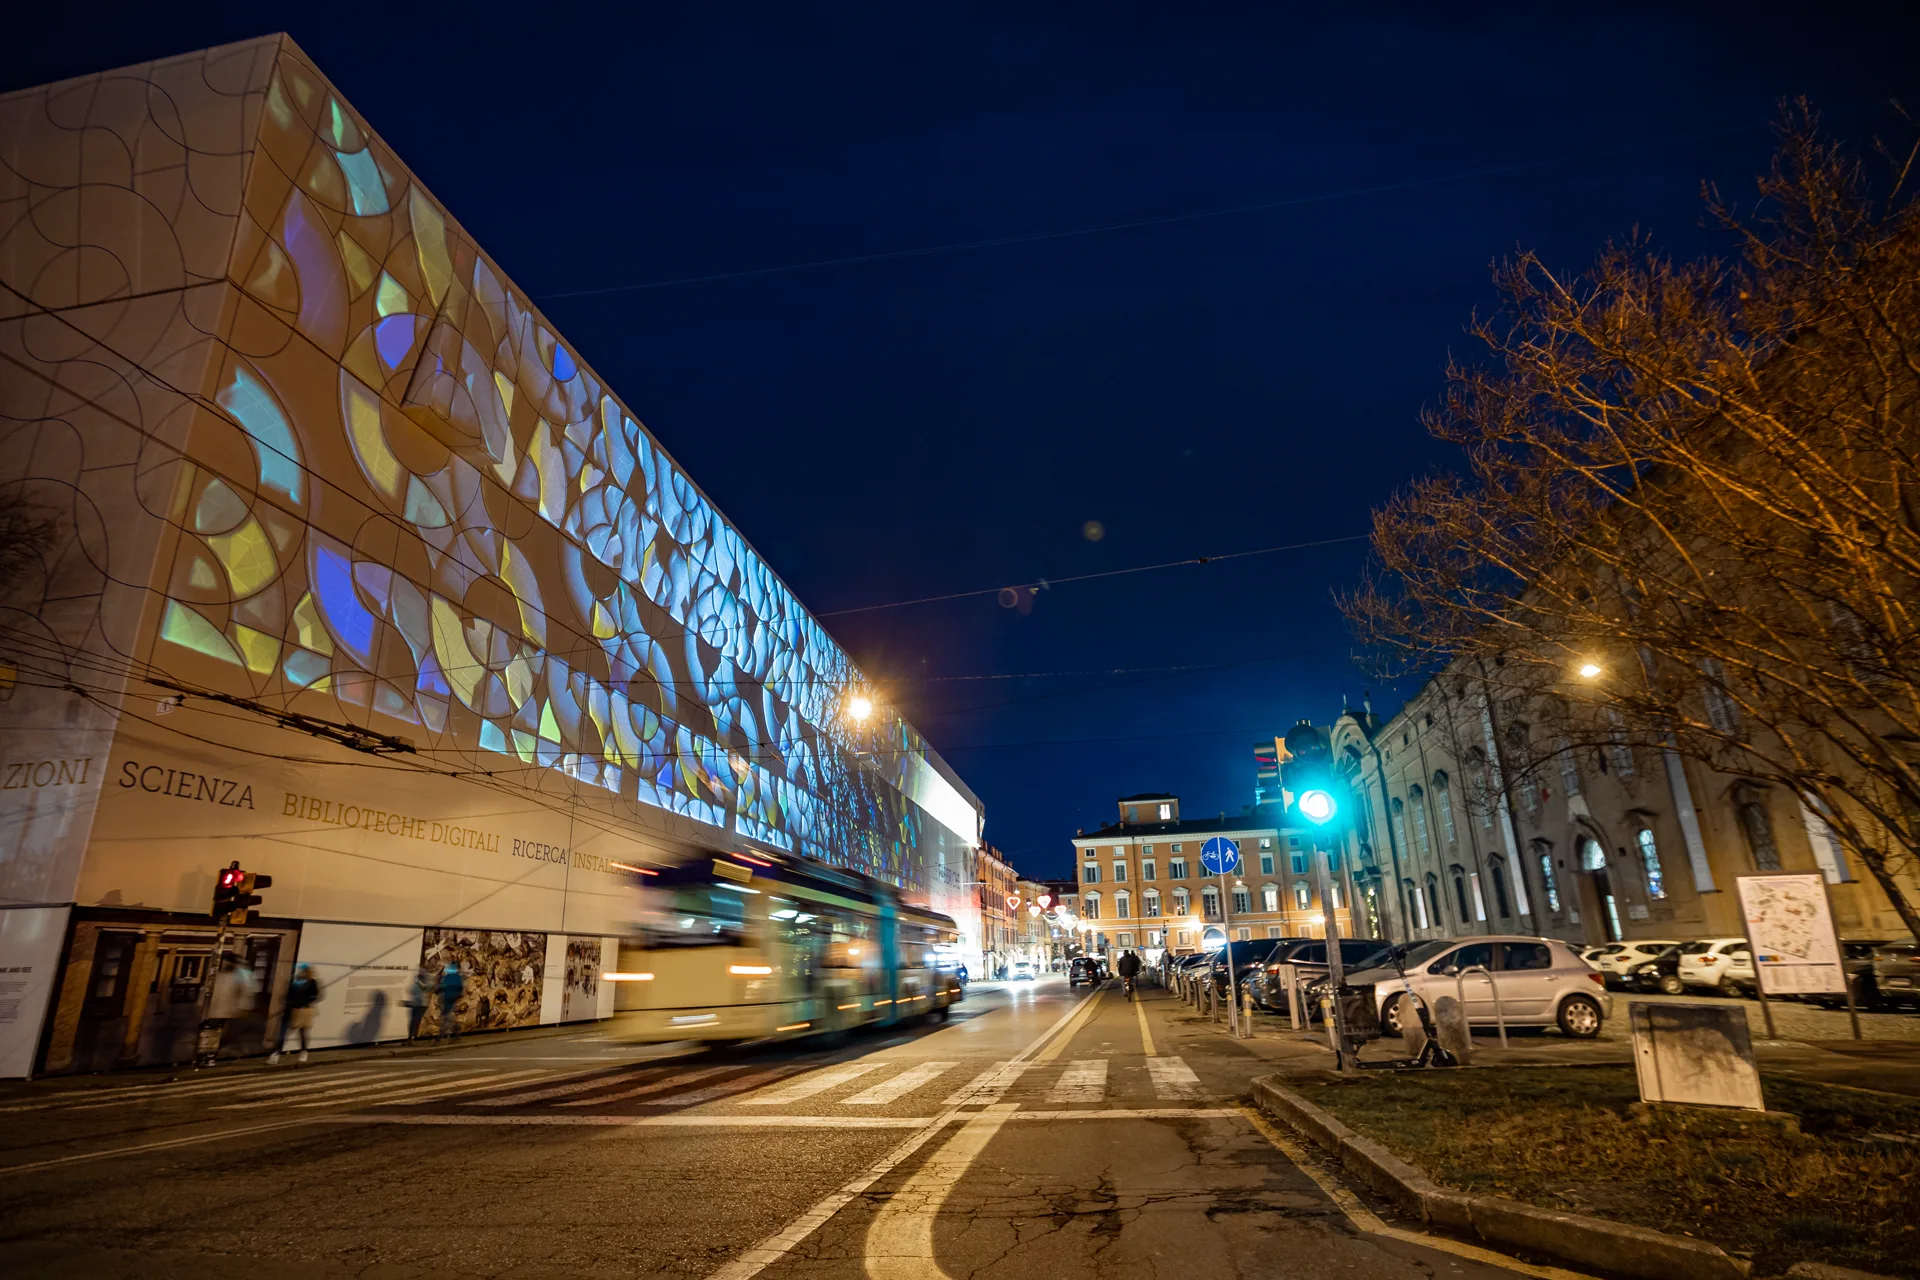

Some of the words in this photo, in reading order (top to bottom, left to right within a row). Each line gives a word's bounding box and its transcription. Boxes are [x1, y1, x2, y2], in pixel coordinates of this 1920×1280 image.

[3, 758, 92, 789] ZIONI
[119, 760, 255, 810] SCIENZA
[281, 792, 427, 840] BIBLIOTECHE
[430, 822, 500, 853] DIGITALI
[512, 838, 567, 865] RICERCA
[573, 852, 648, 878] INSTALLAZIO
